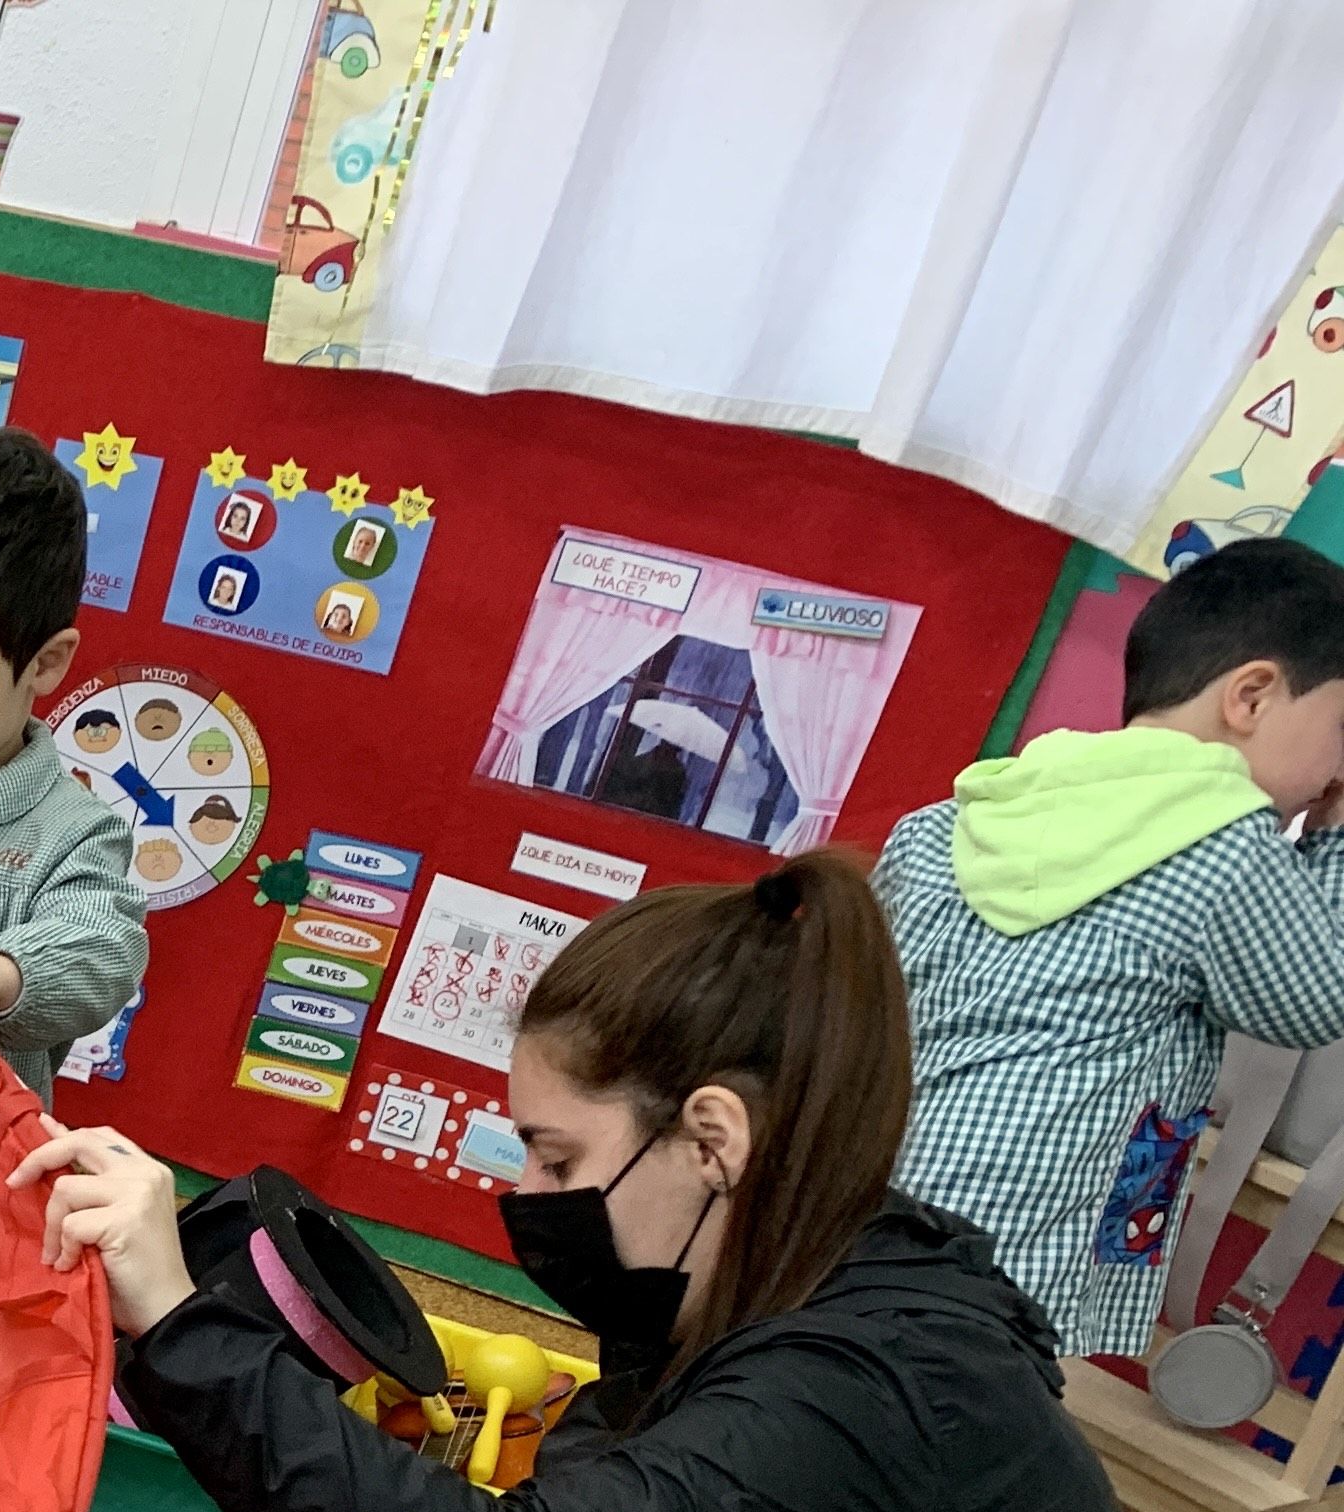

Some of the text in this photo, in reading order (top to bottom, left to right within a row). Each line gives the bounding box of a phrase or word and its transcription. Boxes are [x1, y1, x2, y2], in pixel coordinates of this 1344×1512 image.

[592, 573, 649, 598] HACE?
[621, 562, 682, 590] TIEMPO
[786, 600, 884, 628] LLUVIOSO
[193, 613, 363, 665] RESPONSABLES DE EQUIPO
[140, 667, 189, 686] MIEDO
[226, 705, 266, 769] SORPRESA
[343, 850, 382, 870] LUNES
[584, 862, 602, 877] ES
[603, 867, 638, 885] HOY?
[326, 885, 376, 909] MARTES
[305, 923, 372, 949] MIÉRCOLES
[518, 911, 567, 938] MARZO
[306, 963, 348, 983] JUEVES
[291, 999, 337, 1019] VIERNES
[468, 1007, 484, 1019] 23
[402, 1009, 416, 1021] 28
[431, 1018, 446, 1030] 29
[462, 1028, 476, 1040] 30
[277, 1033, 332, 1057] SÁBADO
[262, 1069, 323, 1094] DOMINGO
[382, 1104, 415, 1132] 22
